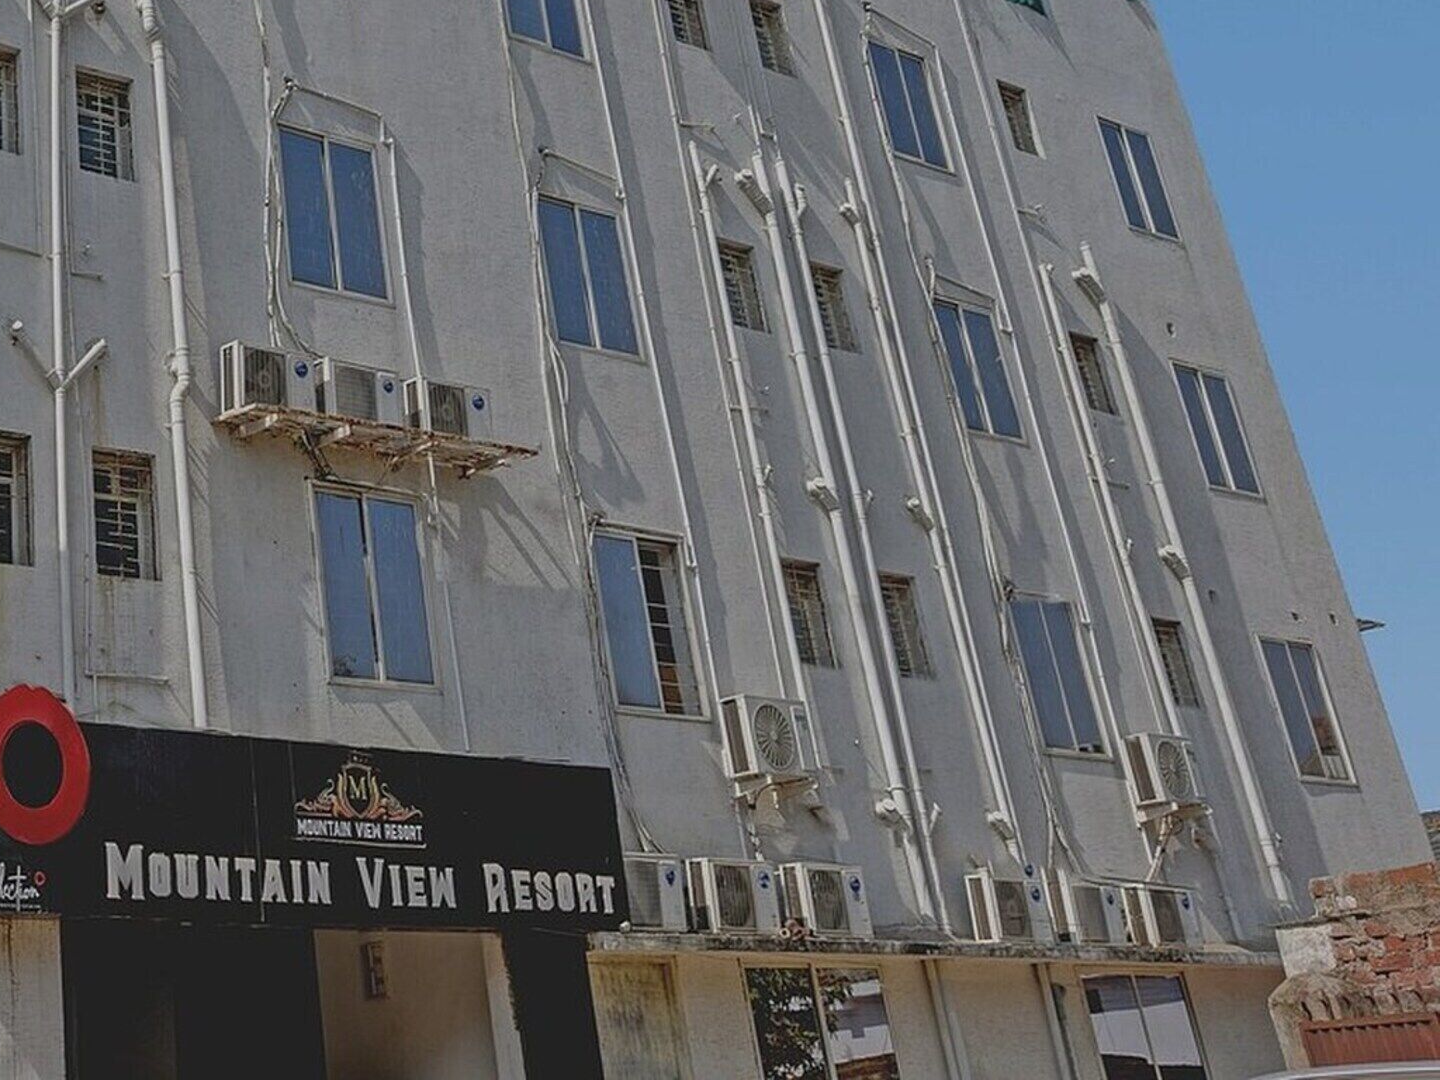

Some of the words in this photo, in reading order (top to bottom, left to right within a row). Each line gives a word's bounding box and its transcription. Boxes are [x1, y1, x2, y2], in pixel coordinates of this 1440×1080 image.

[296, 818, 352, 838] MOUNTAIN
[355, 820, 381, 839] VIEW
[383, 823, 423, 841] RESORT
[104, 841, 333, 905] MOUNTAIN
[355, 856, 458, 910] VIEW
[482, 862, 616, 915] RESORT
